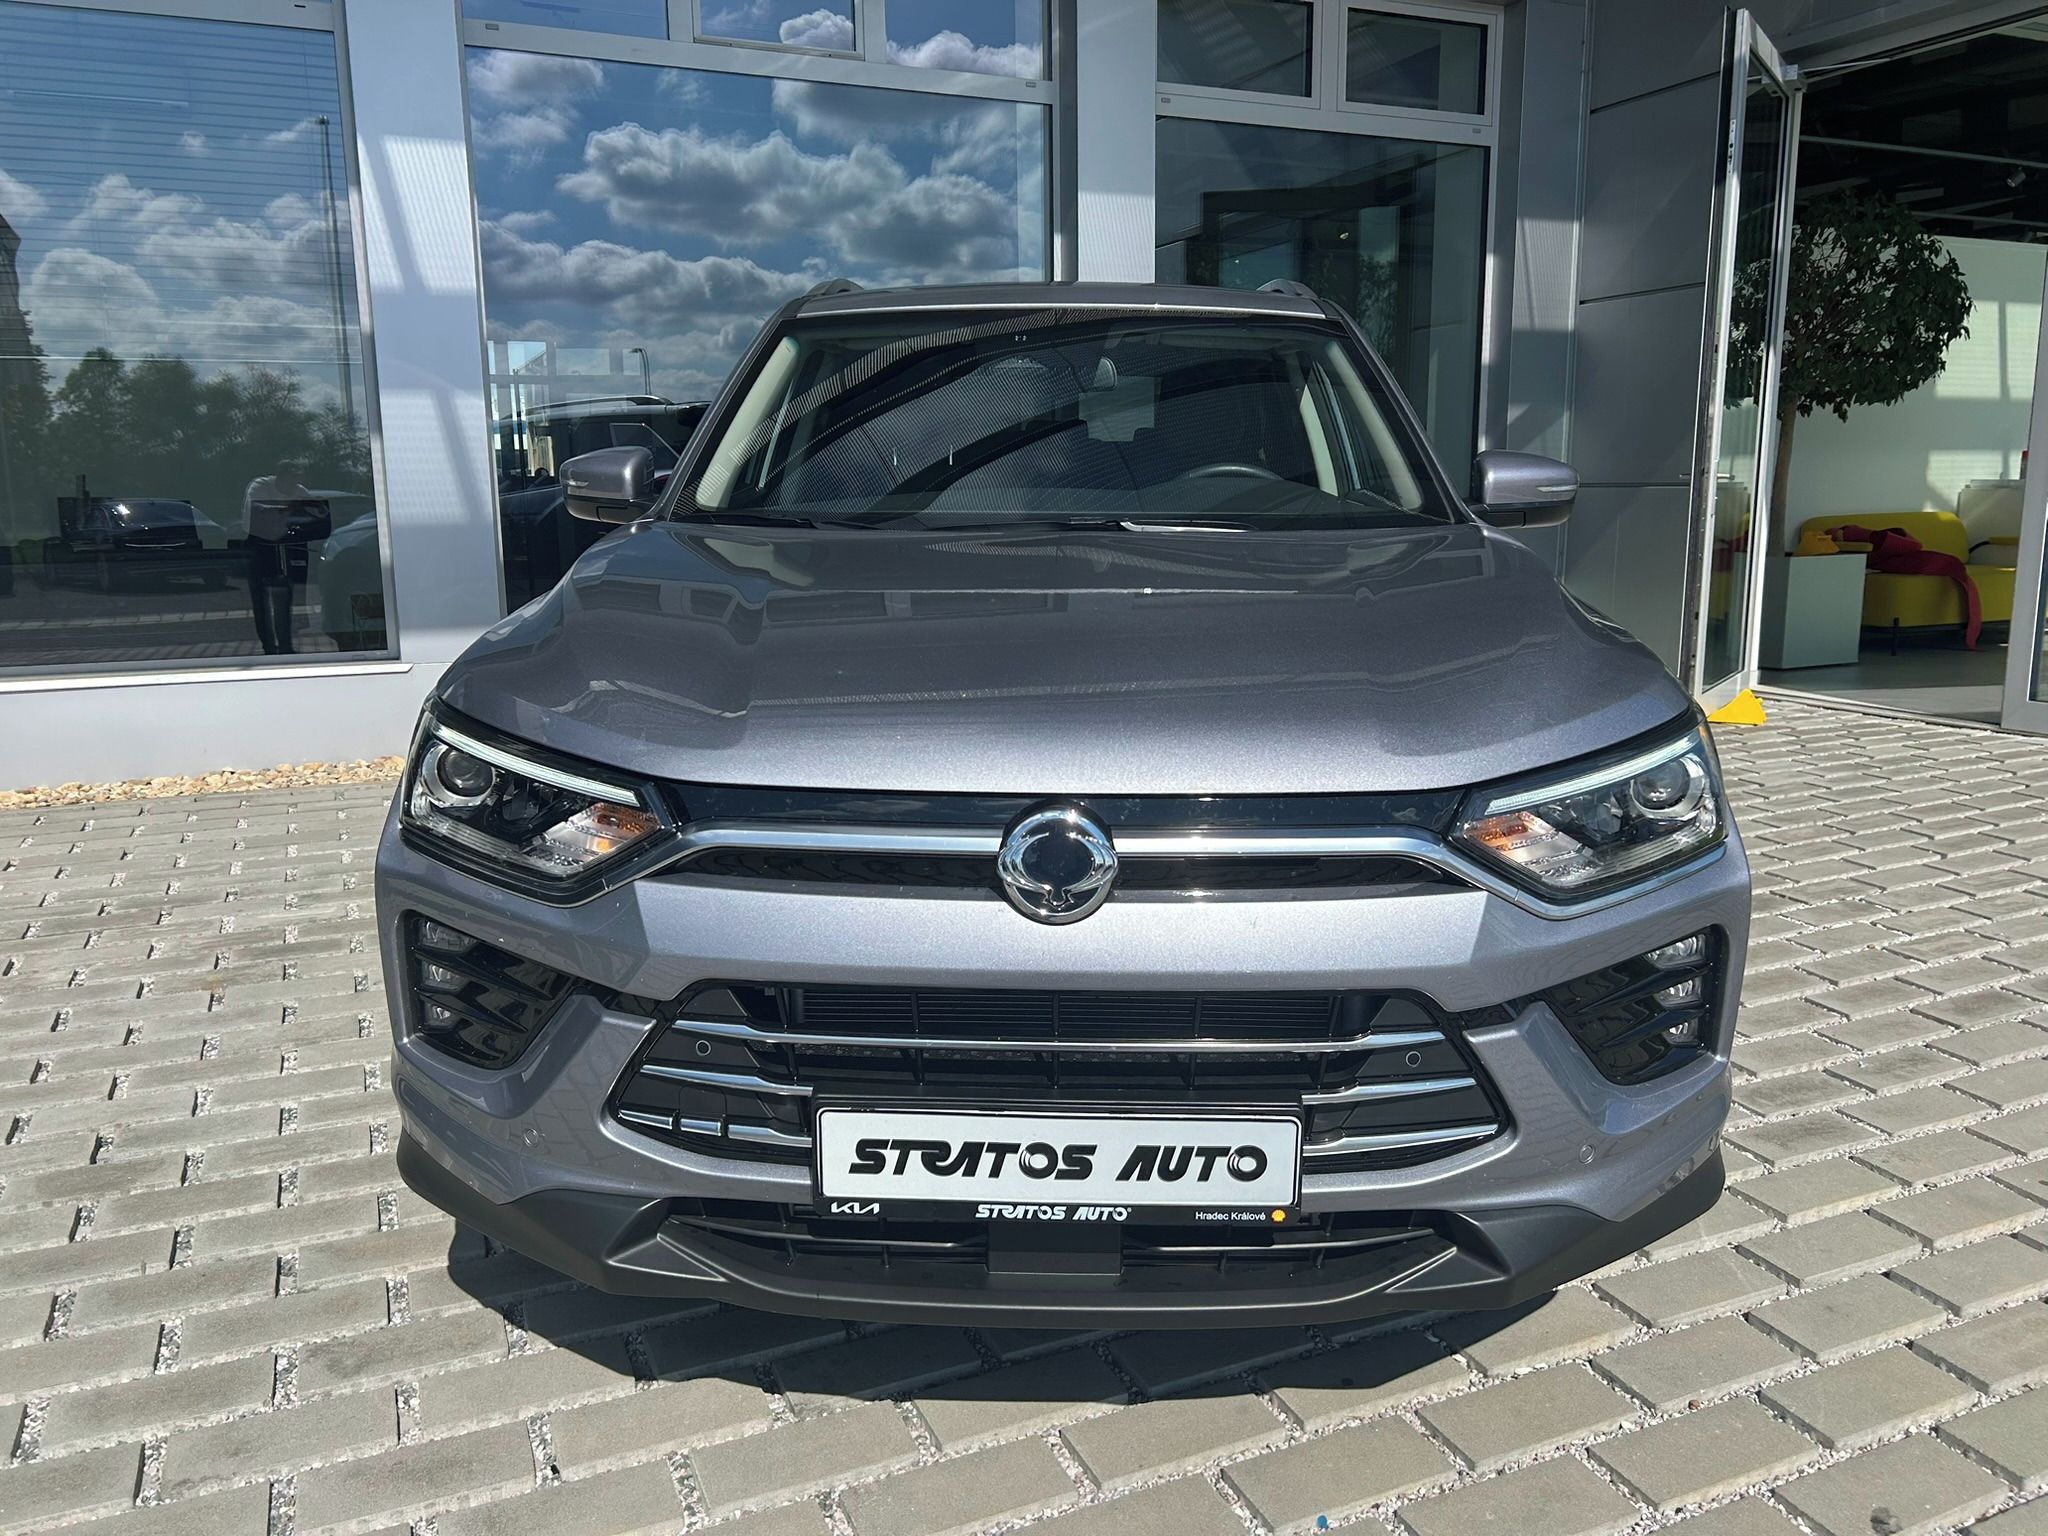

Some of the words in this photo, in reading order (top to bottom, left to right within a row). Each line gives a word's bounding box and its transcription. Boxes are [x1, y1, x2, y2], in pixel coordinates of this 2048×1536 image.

[848, 1138, 1098, 1181] STRATOS
[1115, 1144, 1268, 1183] AUTO
[975, 1203, 1067, 1220] STRATOS
[1195, 1211, 1229, 1220] Hradec
[1231, 1211, 1266, 1221] Králové
